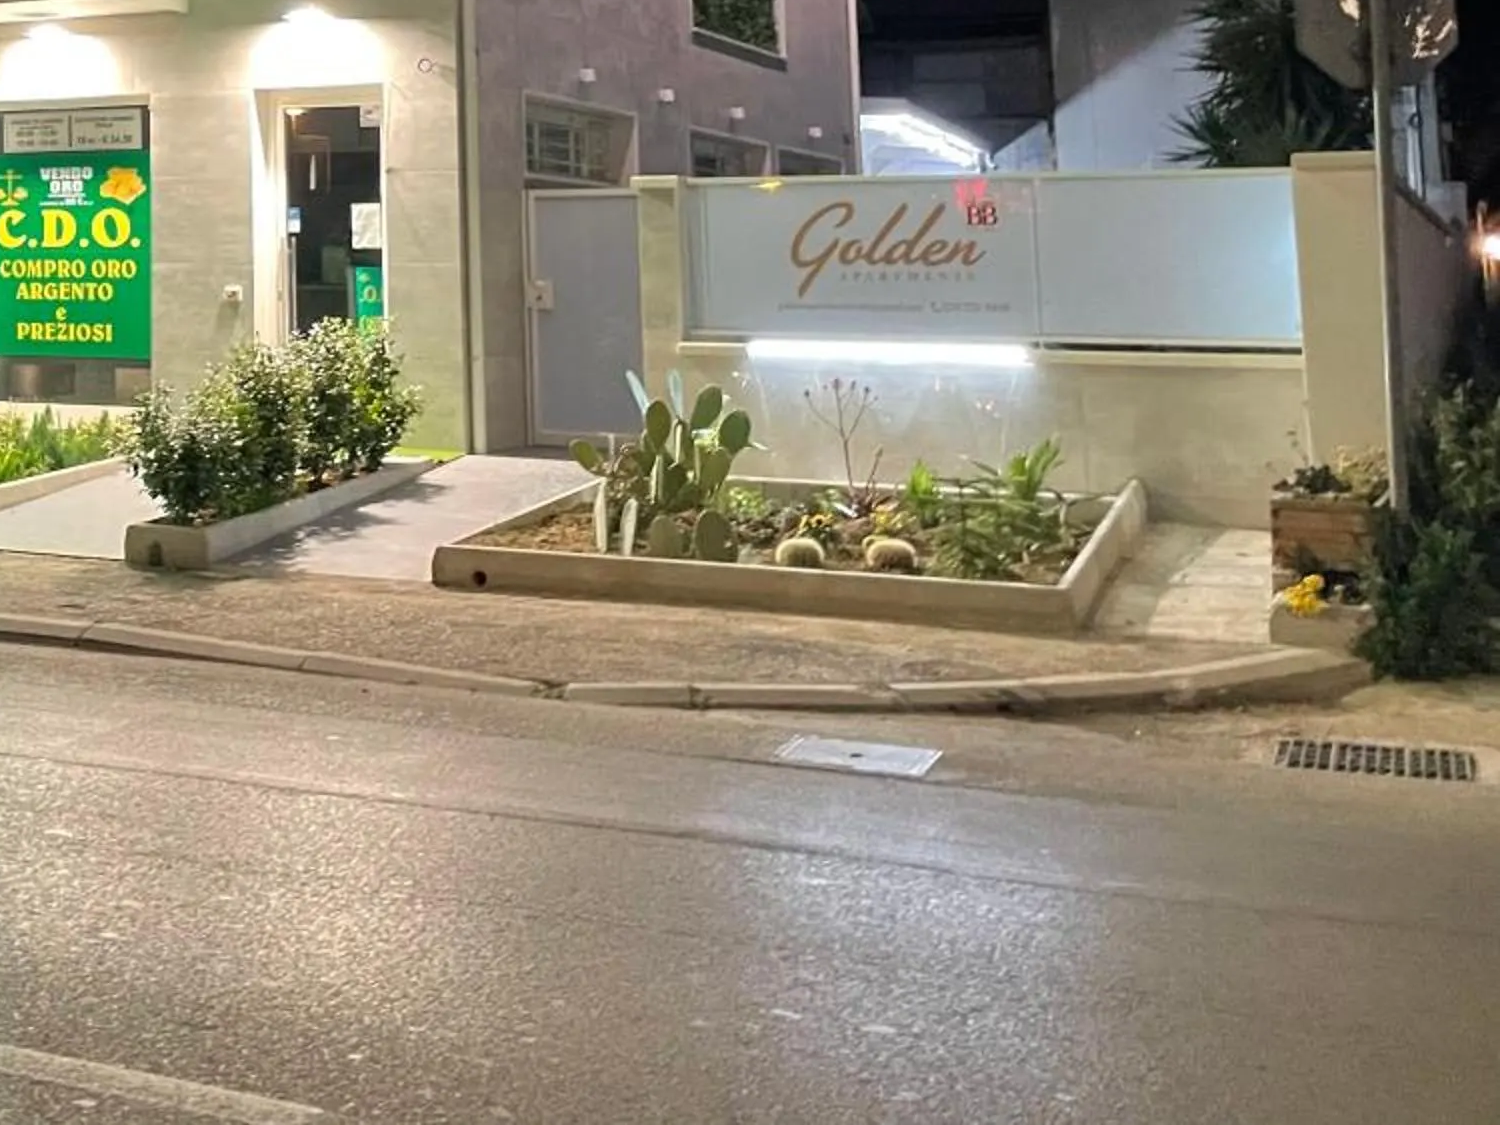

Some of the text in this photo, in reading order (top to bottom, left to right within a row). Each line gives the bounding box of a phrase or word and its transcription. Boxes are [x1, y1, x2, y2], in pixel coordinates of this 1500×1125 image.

[40, 166, 93, 181] VENDO
[49, 180, 84, 194] ORO
[790, 202, 987, 298] Golden
[0, 259, 137, 279] COMPRO ORO
[16, 282, 114, 302] ARGENTO
[55, 306, 68, 321] e
[17, 323, 114, 343] PREZIOSI
